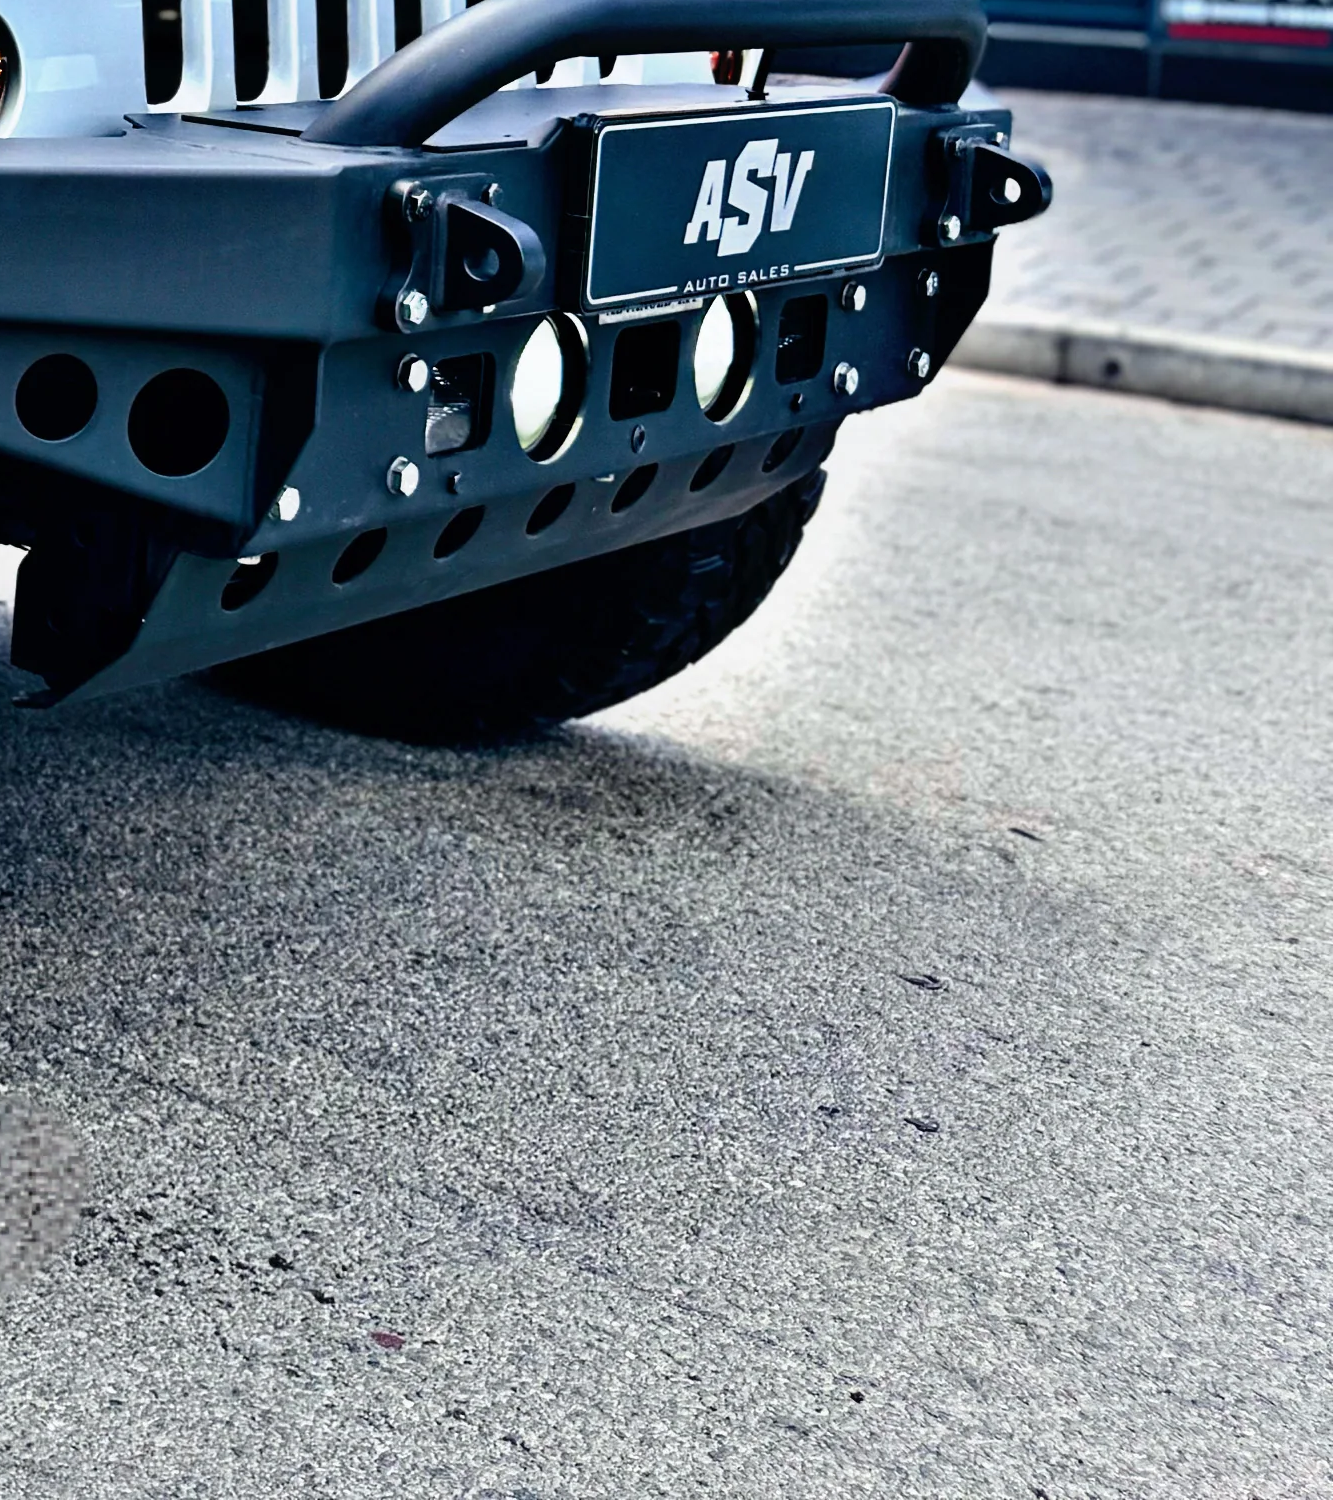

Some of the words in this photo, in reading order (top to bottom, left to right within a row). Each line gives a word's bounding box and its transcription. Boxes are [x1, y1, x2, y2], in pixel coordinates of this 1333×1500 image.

[683, 138, 815, 258] ASV
[683, 275, 730, 294] AUTO
[736, 263, 791, 286] SALES
